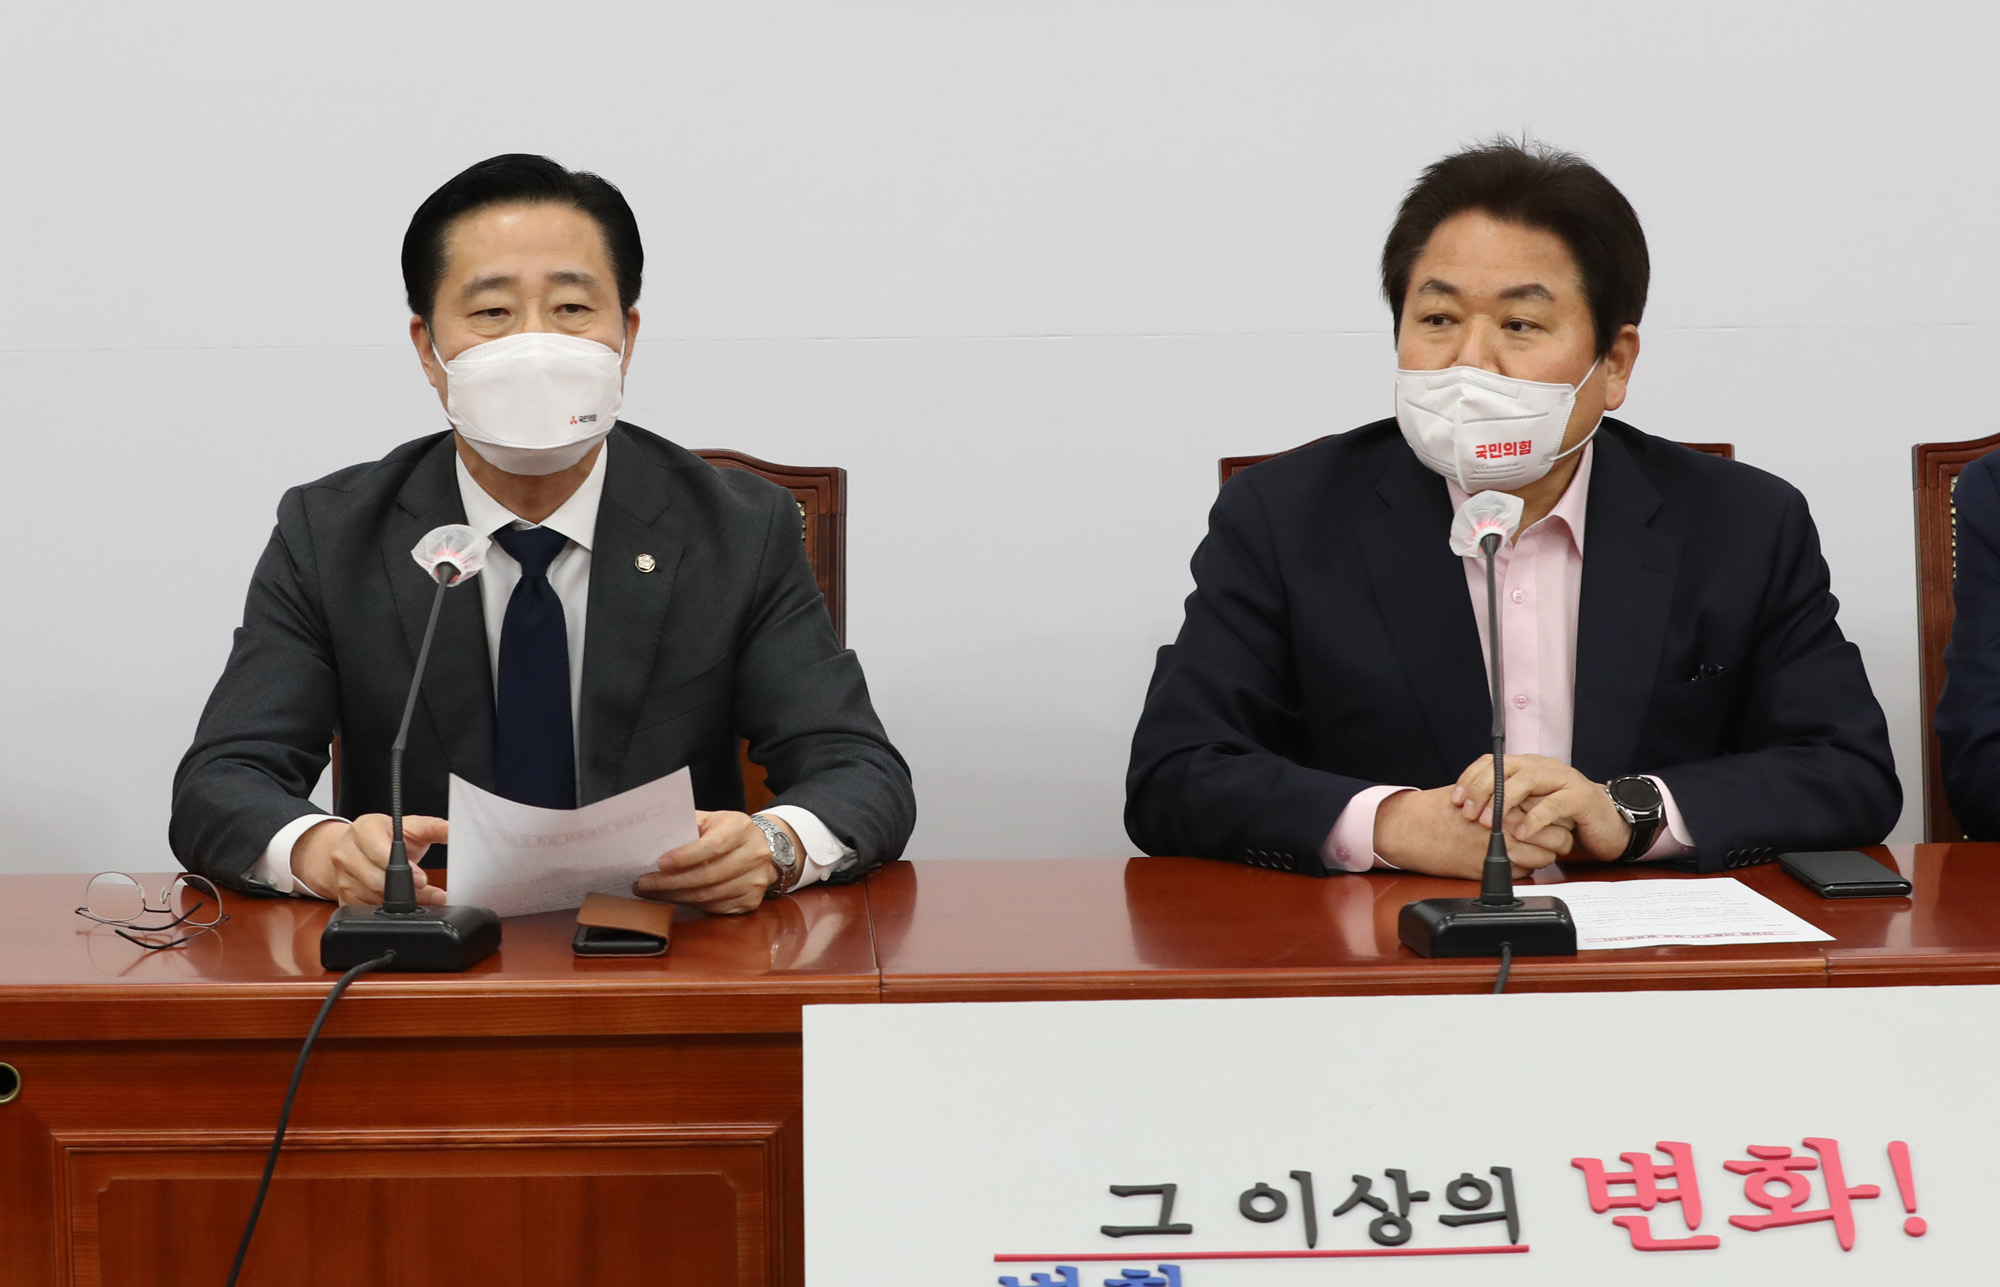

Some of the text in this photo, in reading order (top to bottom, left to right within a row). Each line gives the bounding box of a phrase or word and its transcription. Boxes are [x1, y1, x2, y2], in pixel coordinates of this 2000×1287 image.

[1475, 440, 1532, 459] 국민의힘
[1100, 1137, 1927, 1253] 그 이상의 변화!
